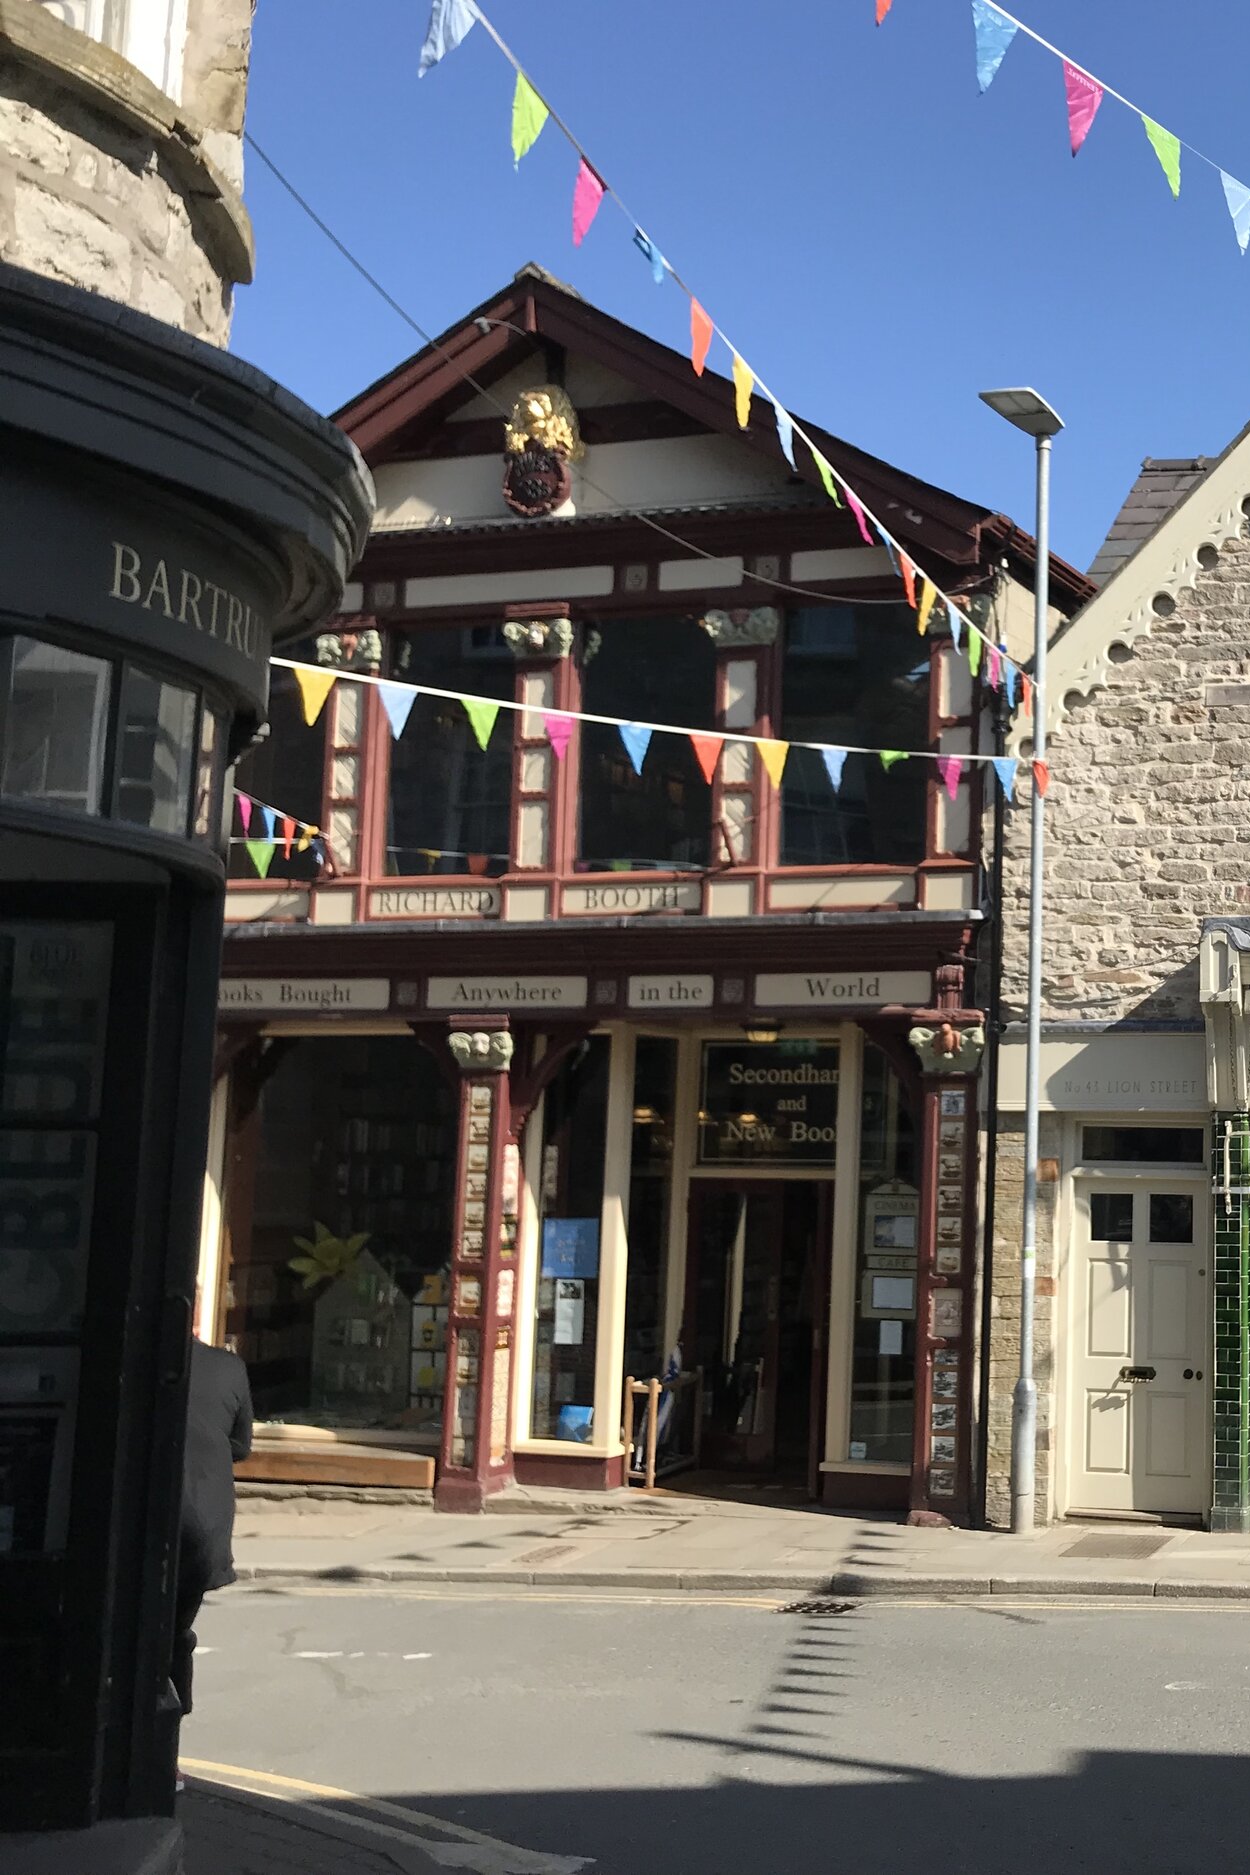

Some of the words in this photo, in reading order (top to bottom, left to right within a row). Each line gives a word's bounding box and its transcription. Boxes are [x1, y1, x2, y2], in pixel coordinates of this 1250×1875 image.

[108, 541, 264, 659] BARTRU
[379, 890, 494, 913] RICHARD
[584, 886, 681, 909] BOOTH
[217, 984, 263, 1001] ooks
[280, 983, 351, 1006] Bought
[454, 981, 562, 1006] Anywhere
[639, 979, 660, 1000] in
[668, 980, 703, 1000] the
[806, 977, 880, 998] World
[1107, 1081, 1141, 1093] LION
[1150, 1080, 1197, 1093] STREET
[777, 1095, 807, 1111] and
[726, 1121, 776, 1141] New
[790, 1121, 837, 1141] Boo
